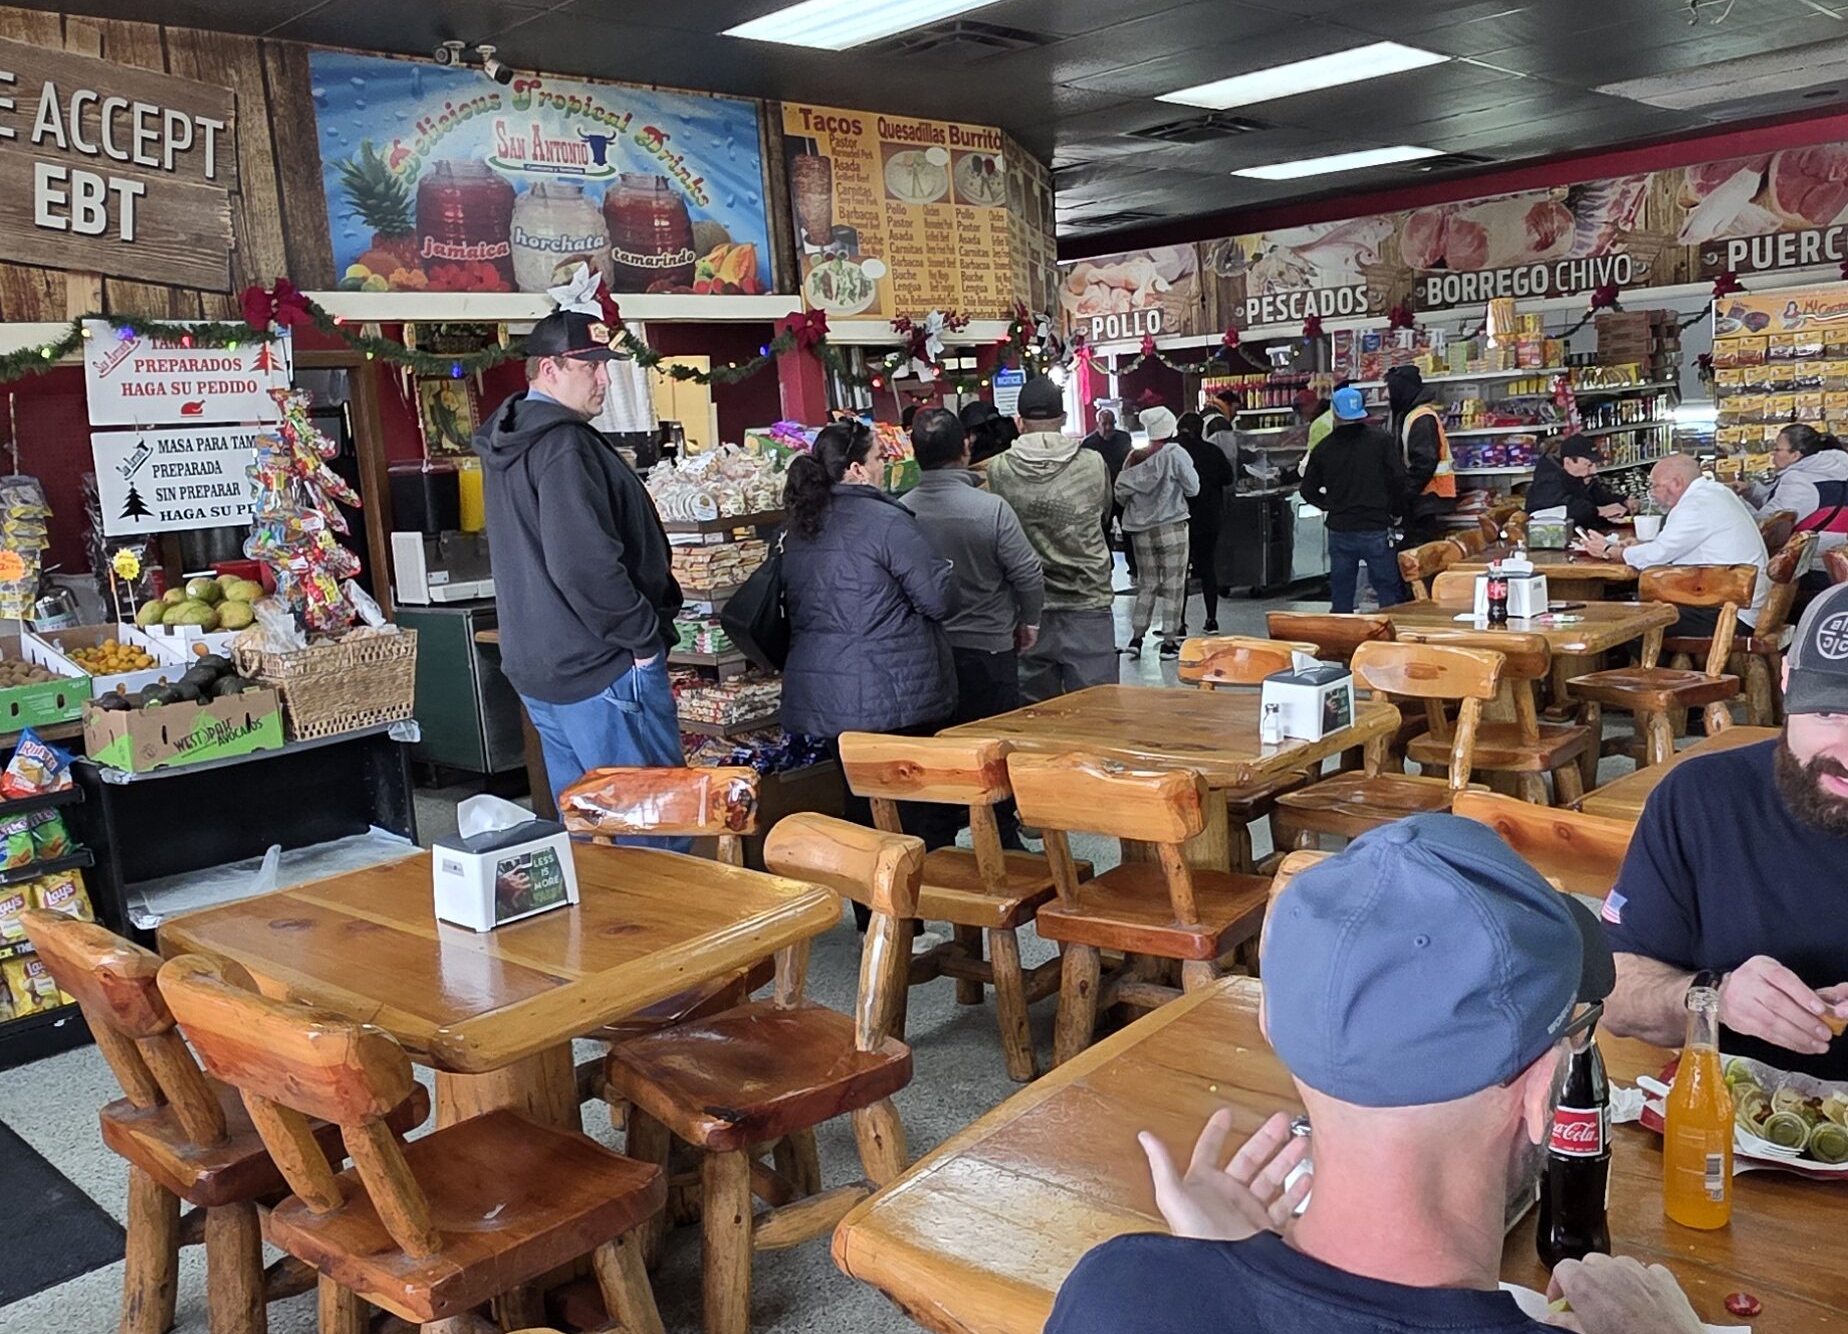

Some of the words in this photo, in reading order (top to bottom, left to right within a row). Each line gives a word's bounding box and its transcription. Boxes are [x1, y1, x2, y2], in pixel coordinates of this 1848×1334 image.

[31, 80, 224, 178] ACCEPT
[798, 107, 863, 136] Tacos
[877, 116, 946, 145] Quesadillas
[390, 93, 502, 185] Delicious
[512, 79, 633, 133] Tropical
[634, 125, 710, 207] Drinks
[834, 158, 860, 172] Asada
[35, 162, 145, 241] EBT
[886, 203, 907, 215] Pollo
[422, 236, 509, 260] jamaica
[514, 227, 604, 253] horchata
[1728, 227, 1848, 272] PUERC
[613, 248, 695, 267] tamarindo
[1427, 264, 1549, 306] BORREGO
[1555, 254, 1633, 294] CHIVO
[1247, 285, 1368, 326] PESCADOS
[1092, 310, 1161, 341] POLLO
[134, 358, 242, 373] PREPARADOS
[121, 382, 167, 396] HAGA
[171, 381, 191, 396] SU
[197, 380, 257, 395] PEDIDO
[157, 439, 193, 454] MASA
[197, 436, 228, 452] PARA
[152, 460, 222, 478] PREPARADA
[156, 488, 177, 502] SIN
[180, 482, 241, 500] PREPARAR
[160, 508, 206, 521] HAGA
[211, 505, 231, 518] SU
[173, 730, 203, 753] WEST
[534, 854, 554, 867] LESS
[534, 875, 559, 890] MORE
[541, 867, 549, 877] IS
[45, 882, 74, 906] Lay's
